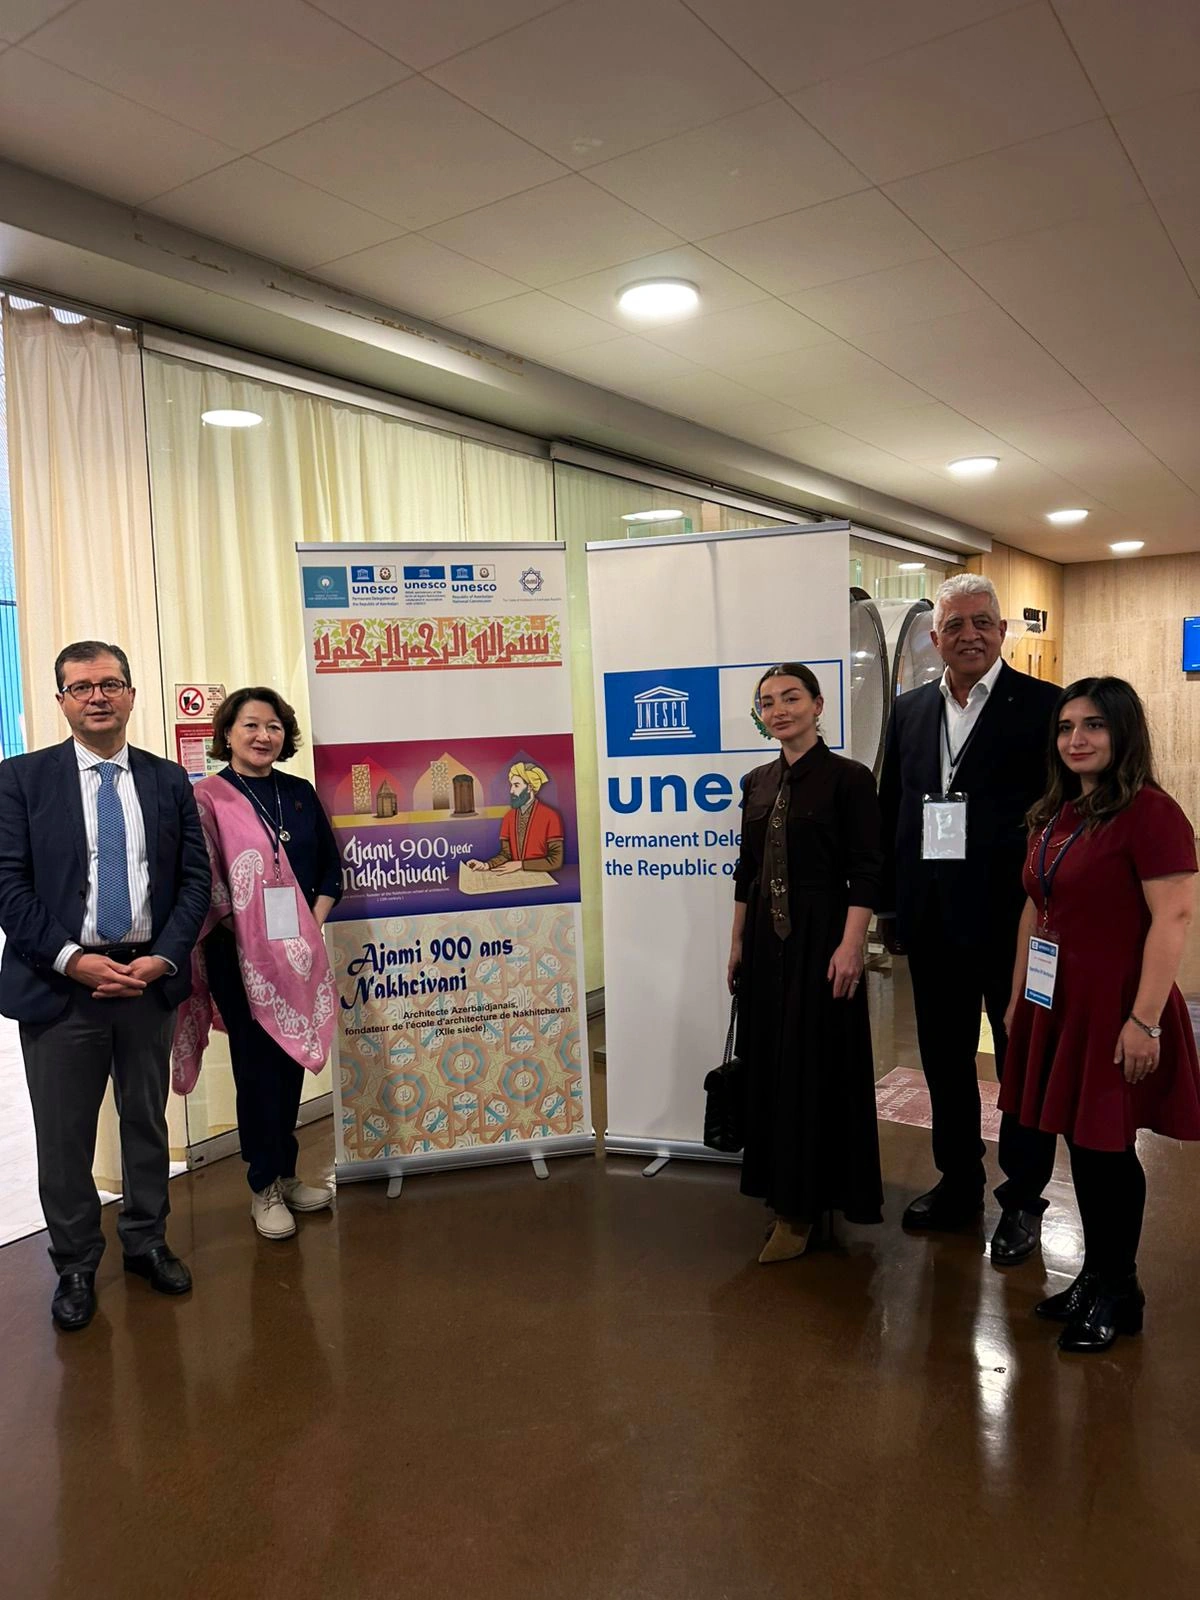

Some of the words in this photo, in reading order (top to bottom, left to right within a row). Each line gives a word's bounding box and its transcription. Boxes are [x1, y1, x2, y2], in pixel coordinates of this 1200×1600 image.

[352, 585, 398, 594] unesco
[404, 581, 447, 589] unesco
[451, 583, 497, 592] unesco
[638, 702, 687, 728] UNESCO
[608, 773, 747, 814] une
[605, 831, 699, 848] Permanent
[343, 835, 396, 868] Ajami
[400, 837, 448, 861] 900
[450, 843, 473, 859] year
[605, 859, 633, 876] the
[638, 858, 717, 880] Republic
[347, 939, 422, 976] Ajami
[430, 936, 472, 963] 900
[480, 938, 513, 957] ans
[340, 967, 467, 1009] Nakhcivani
[345, 1024, 389, 1036] fondateur
[392, 1023, 404, 1031] de
[405, 1019, 435, 1030] l'école
[437, 1013, 498, 1026] d'architecture
[500, 1011, 511, 1020] de
[513, 1005, 571, 1019] Nakhitchevan
[403, 1007, 448, 1020] Architecte
[435, 1027, 455, 1038] (XIIe
